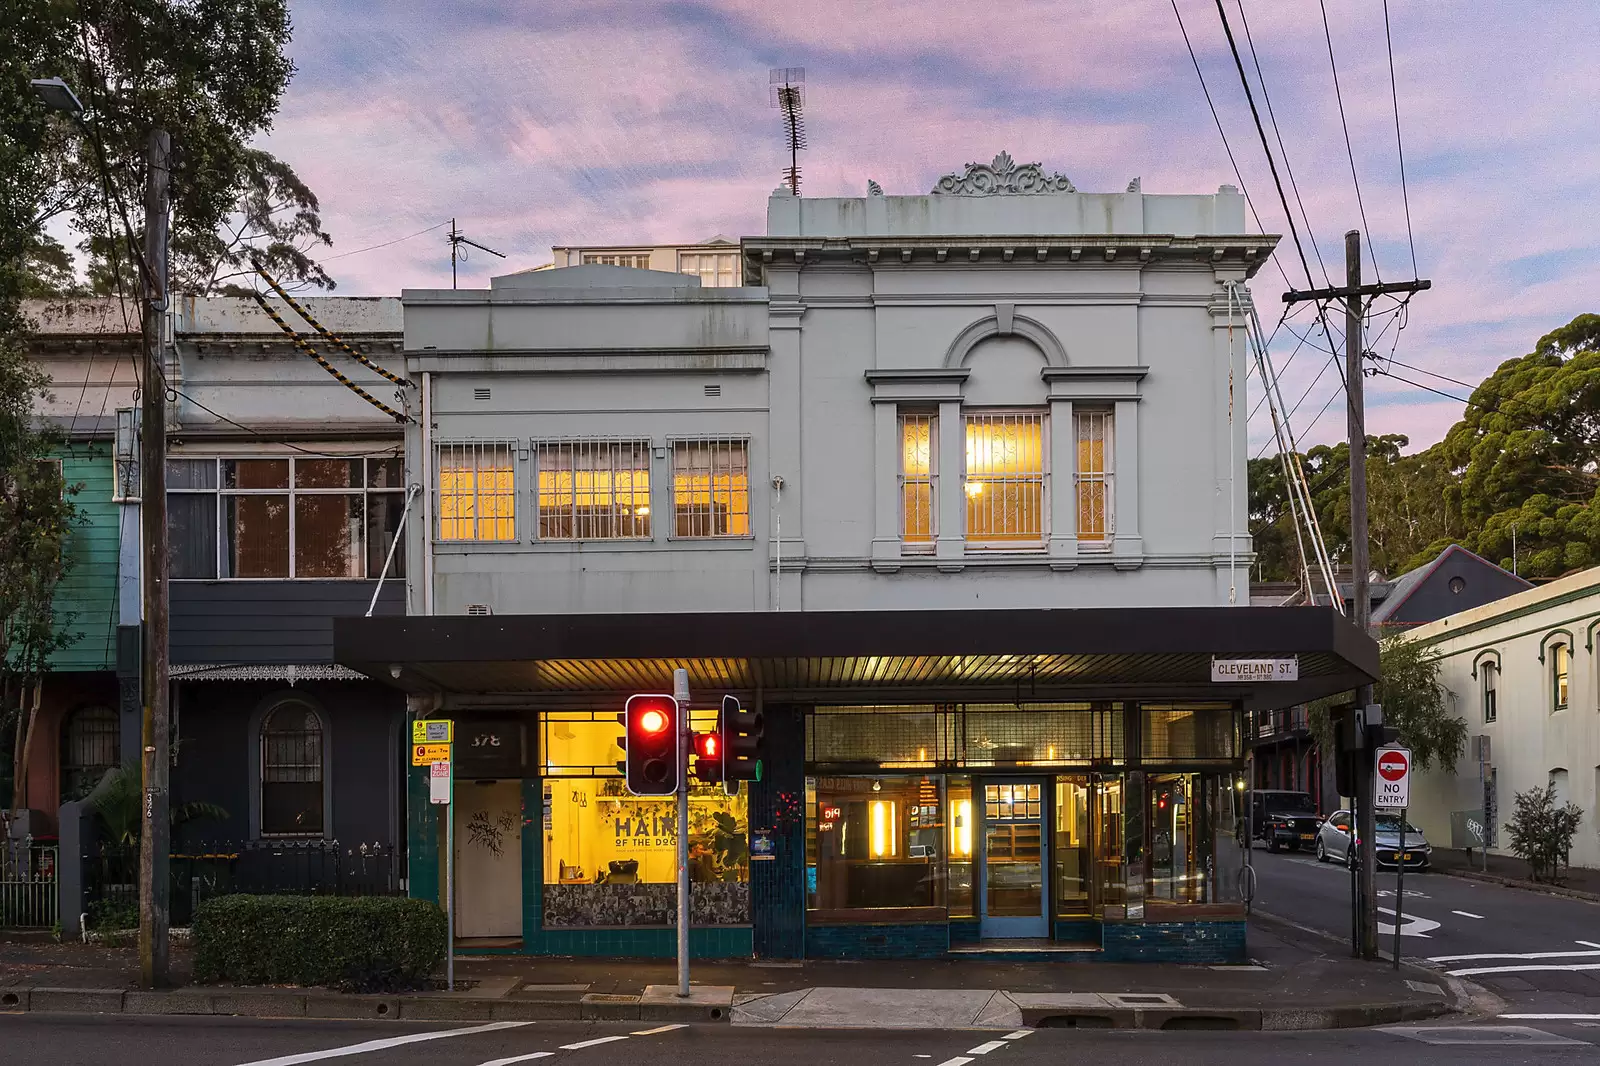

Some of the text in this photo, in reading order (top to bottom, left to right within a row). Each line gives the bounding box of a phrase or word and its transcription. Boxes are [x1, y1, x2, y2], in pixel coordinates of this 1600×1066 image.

[1218, 663, 1292, 674] CLEVELAND ST.
[1384, 783, 1400, 793] NO
[1378, 795, 1405, 803] ENTRY
[615, 817, 677, 837] HAIR
[615, 838, 677, 847] OF THE DOG
